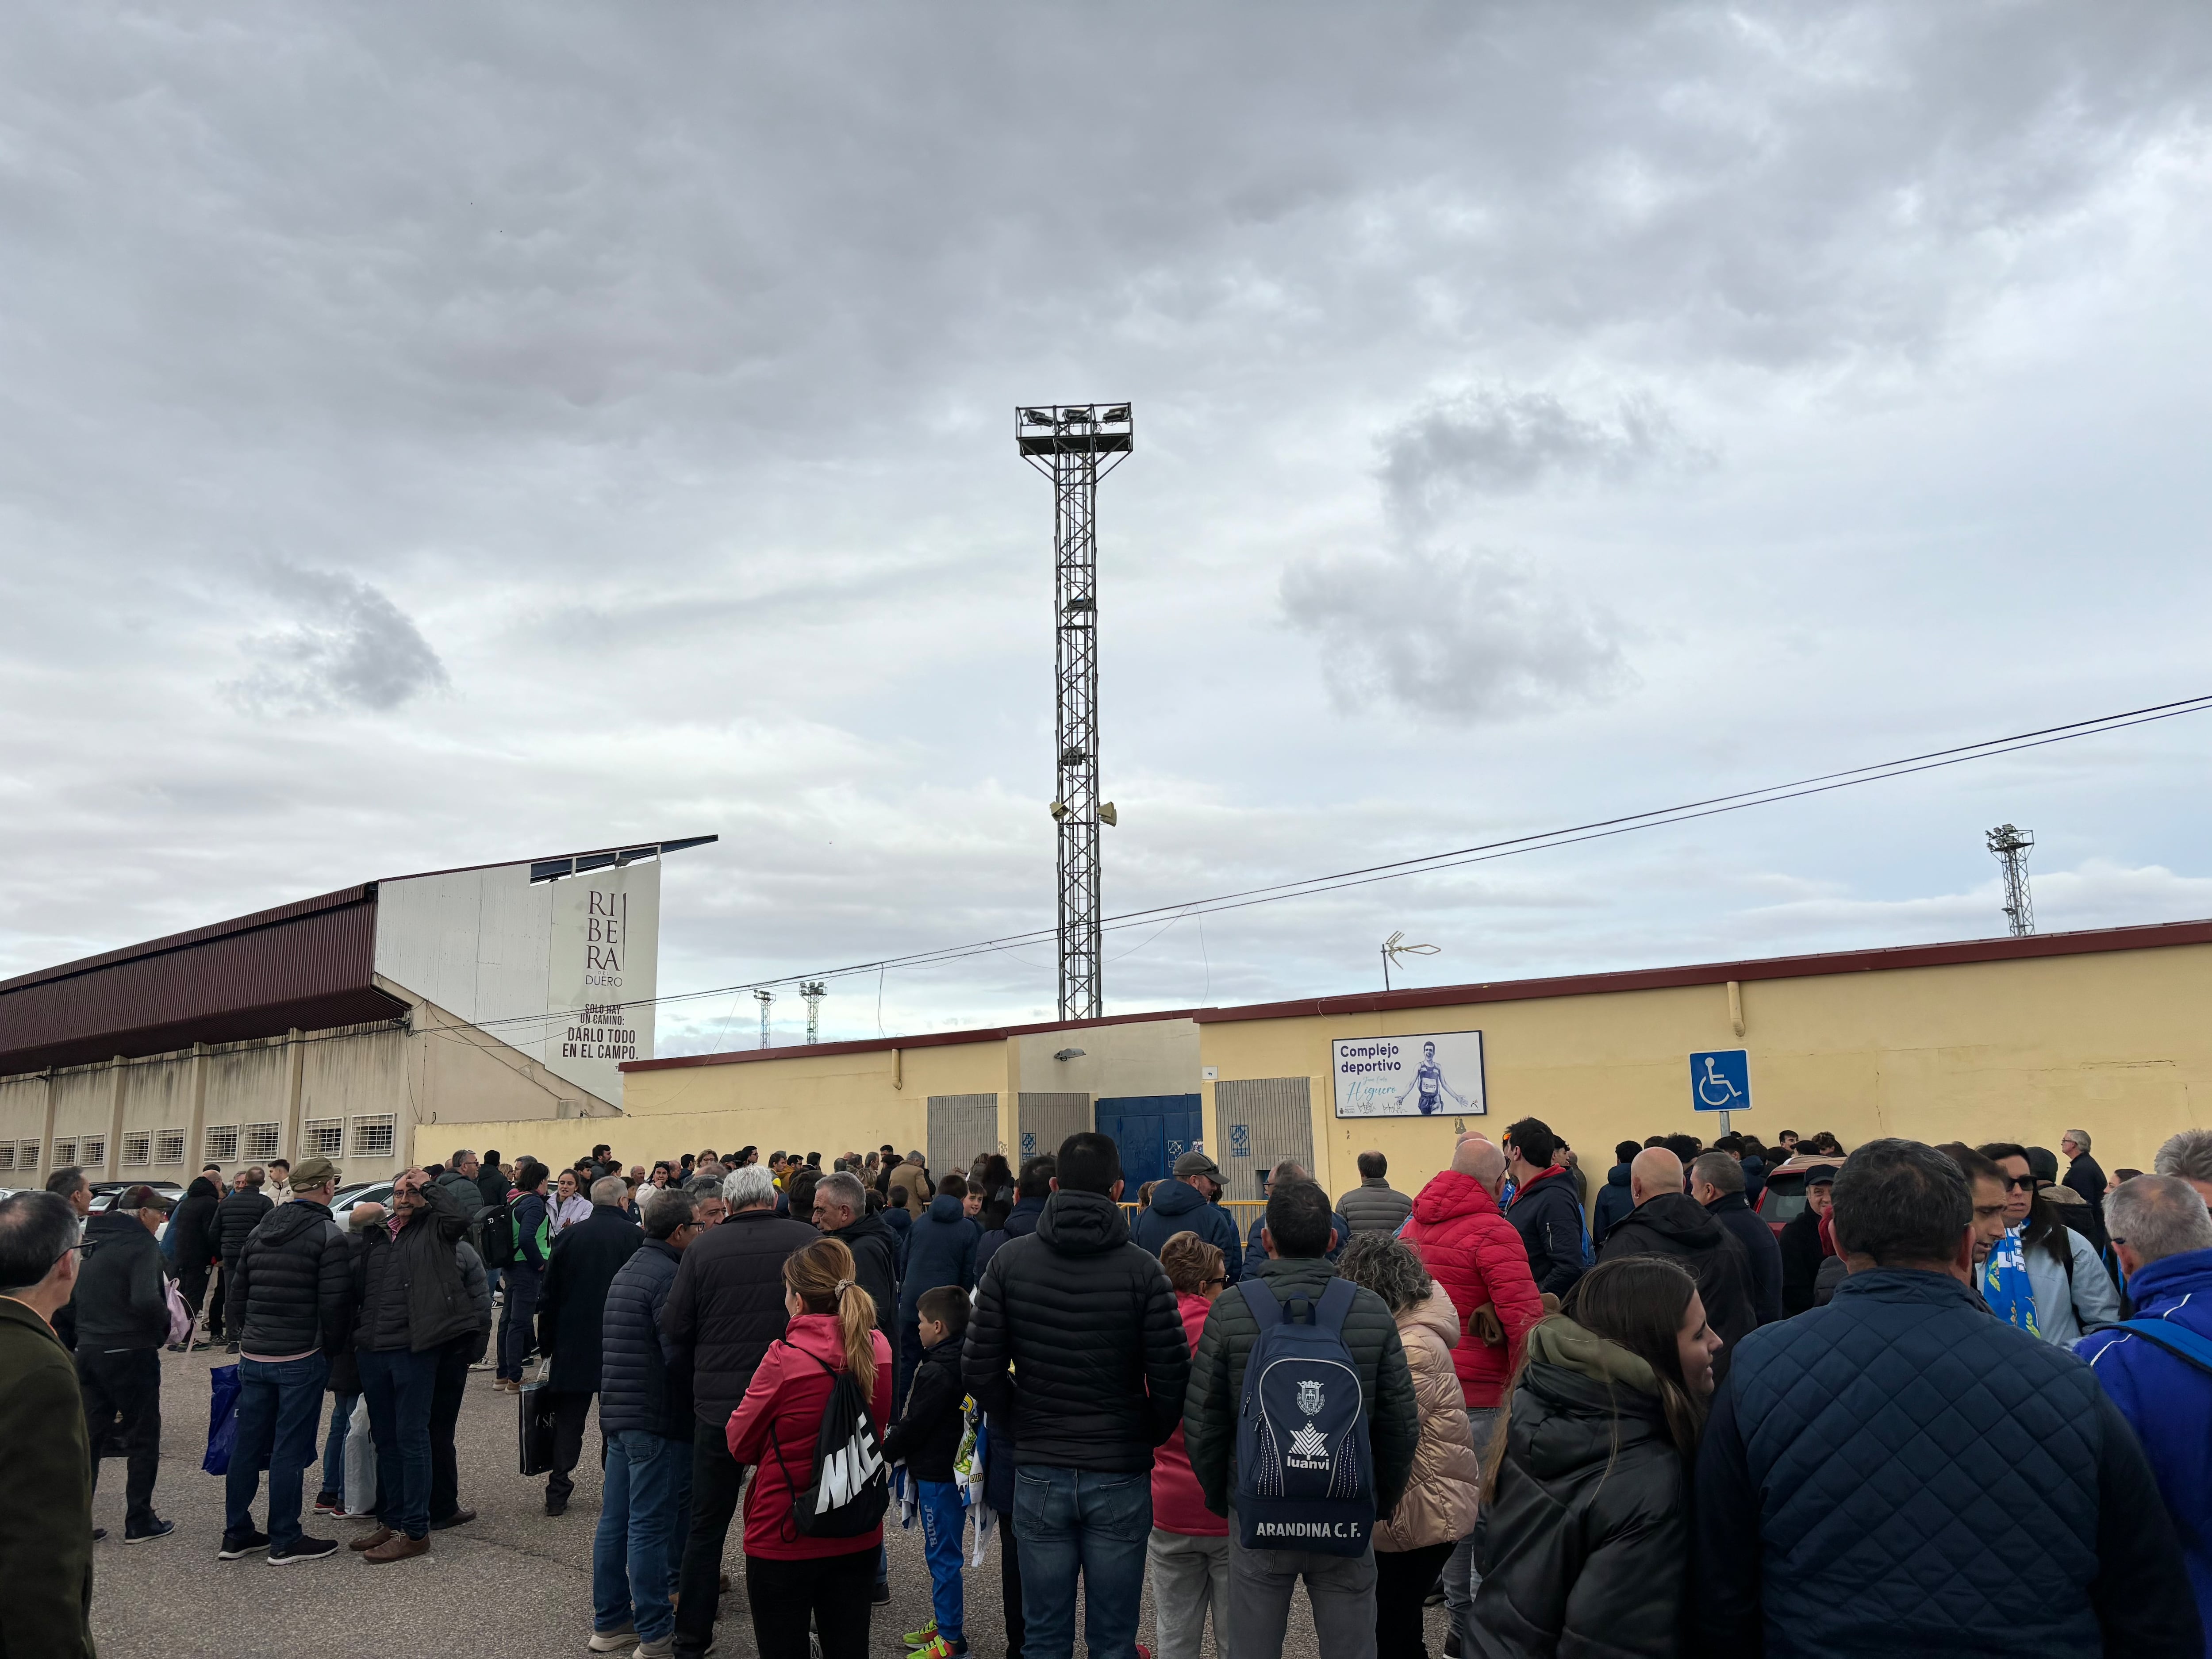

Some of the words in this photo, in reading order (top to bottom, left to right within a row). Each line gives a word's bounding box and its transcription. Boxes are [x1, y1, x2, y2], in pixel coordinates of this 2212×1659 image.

[586, 975, 622, 987] DUERO
[585, 1004, 604, 1014] SOLO
[607, 1005, 621, 1015] HAY
[580, 1013, 590, 1023] UN
[593, 1014, 625, 1025] CAMINO:
[568, 1027, 603, 1042] DARLO
[608, 1029, 635, 1044] TODO
[563, 1043, 576, 1057] EN
[581, 1044, 593, 1058] EL
[598, 1045, 638, 1060] CAMPO.
[1340, 1043, 1399, 1059] Complejo
[1341, 1059, 1401, 1075] deportivo
[1346, 1082, 1396, 1104] Higuero
[814, 1412, 883, 1515] NIKE
[1287, 1456, 1329, 1470] luanvi
[924, 1505, 937, 1547] Joma
[1256, 1522, 1331, 1537] ARANDINA
[1334, 1523, 1347, 1538] C.
[1351, 1523, 1361, 1538] F.
